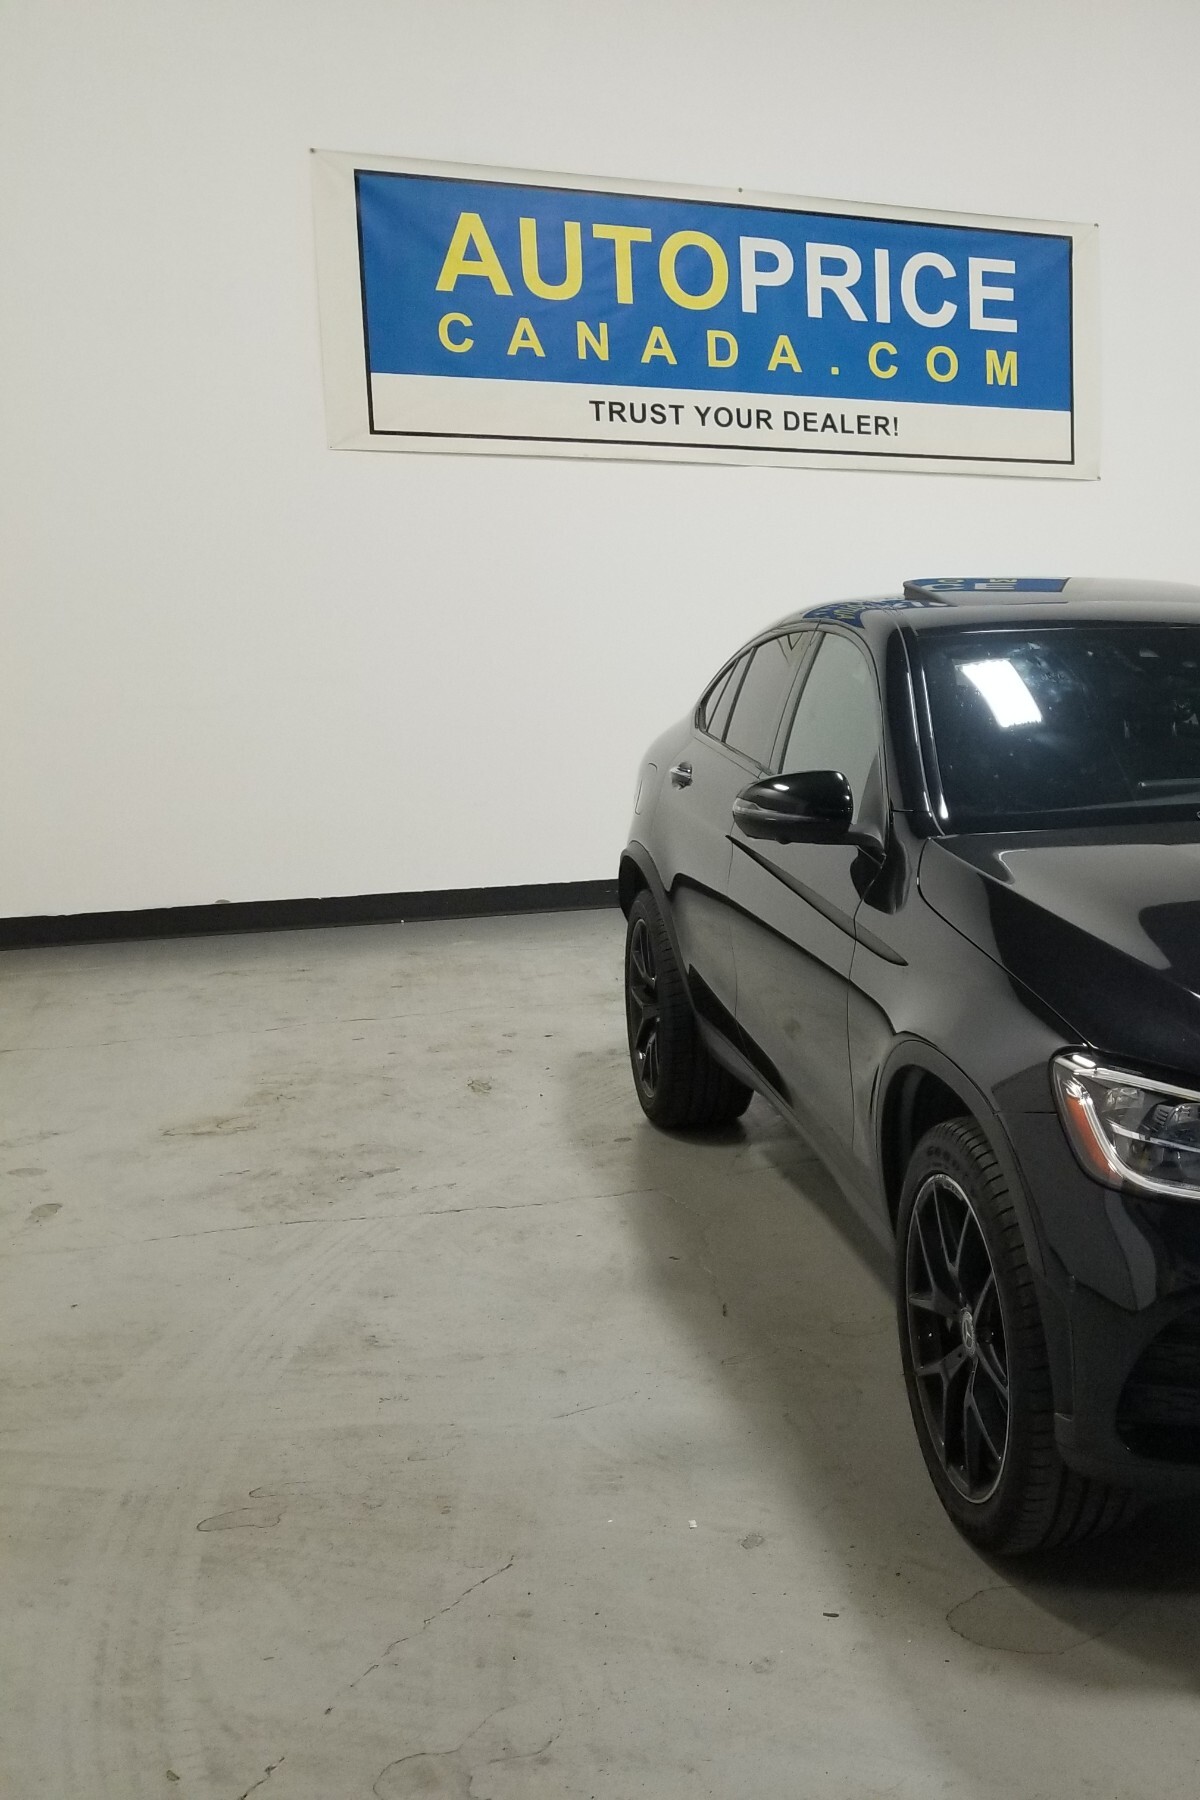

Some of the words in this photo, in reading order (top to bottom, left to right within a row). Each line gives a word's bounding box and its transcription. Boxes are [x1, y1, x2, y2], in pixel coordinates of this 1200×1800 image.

[435, 212, 1018, 332] AUTOPRICE
[438, 312, 1018, 386] CANADA.COM
[588, 400, 684, 425] TRUST
[693, 406, 773, 430] YOUR
[783, 410, 899, 436] DEALER!
